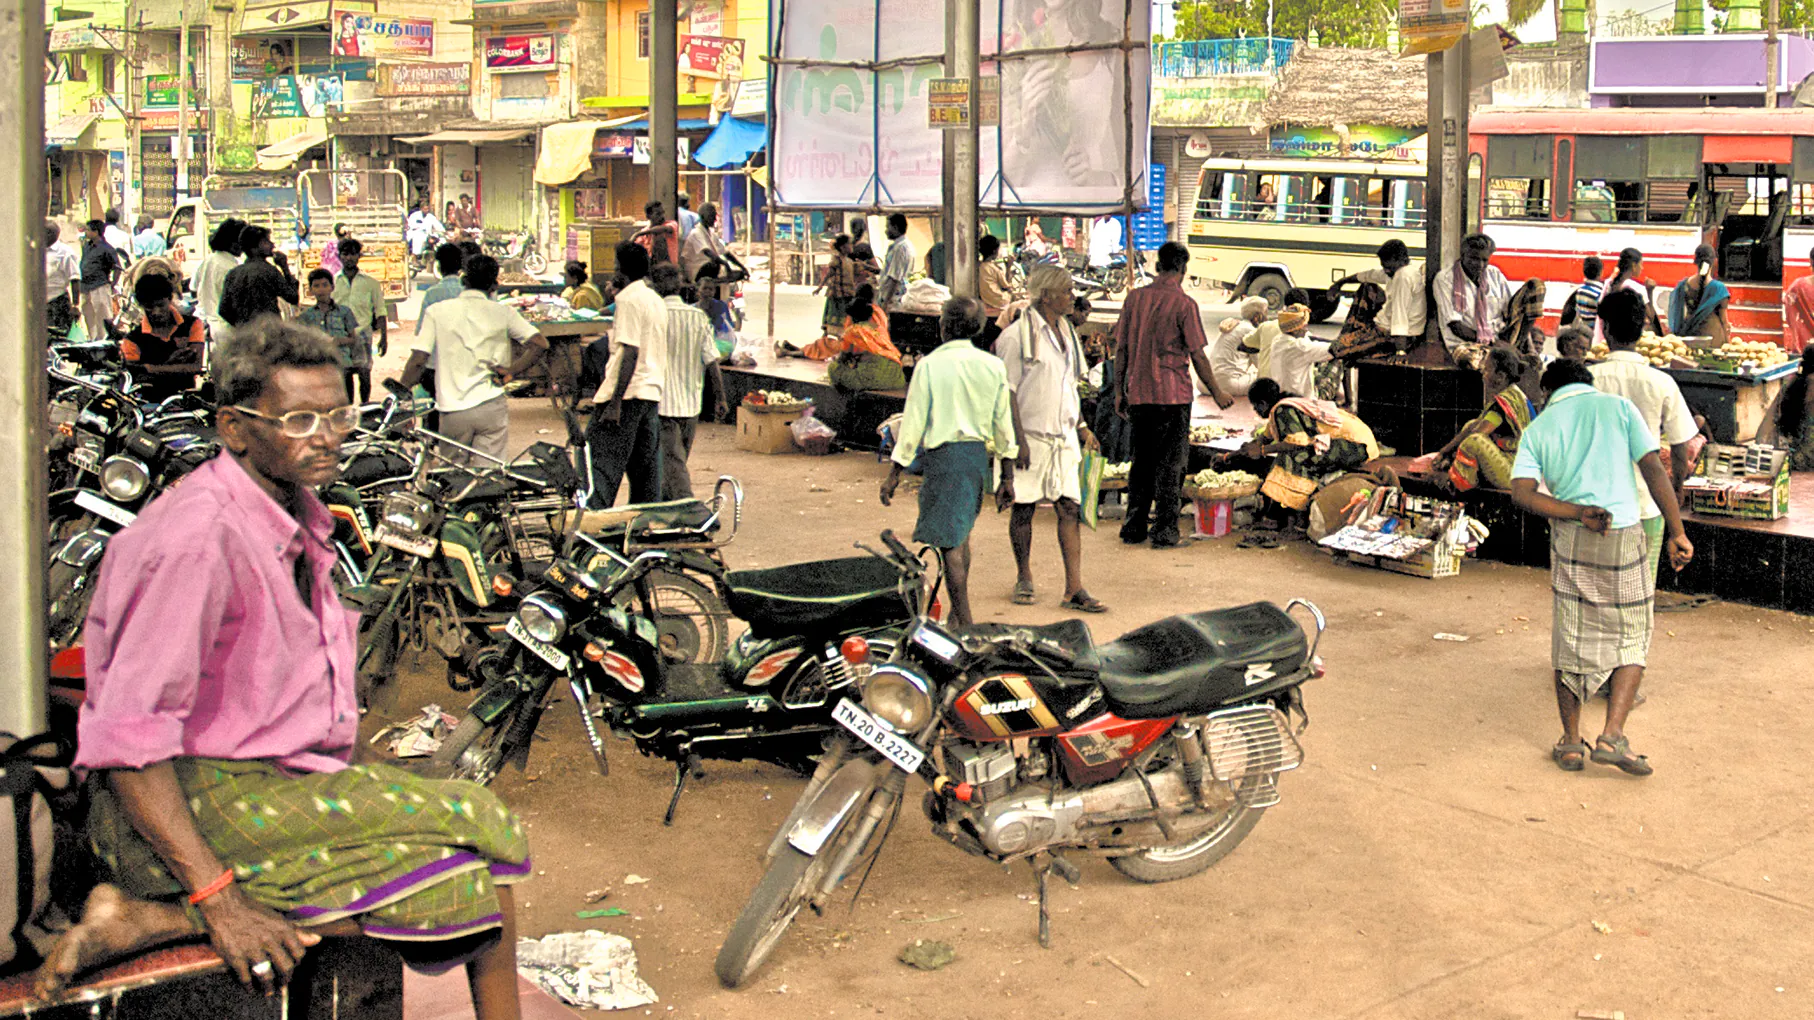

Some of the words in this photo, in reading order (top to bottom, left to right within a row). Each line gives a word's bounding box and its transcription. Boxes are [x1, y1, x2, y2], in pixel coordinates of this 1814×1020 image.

[745, 699, 768, 713] XL
[980, 697, 1037, 715] SUZUKI
[839, 705, 875, 737] TN.20
[873, 732, 917, 766] B.2227
